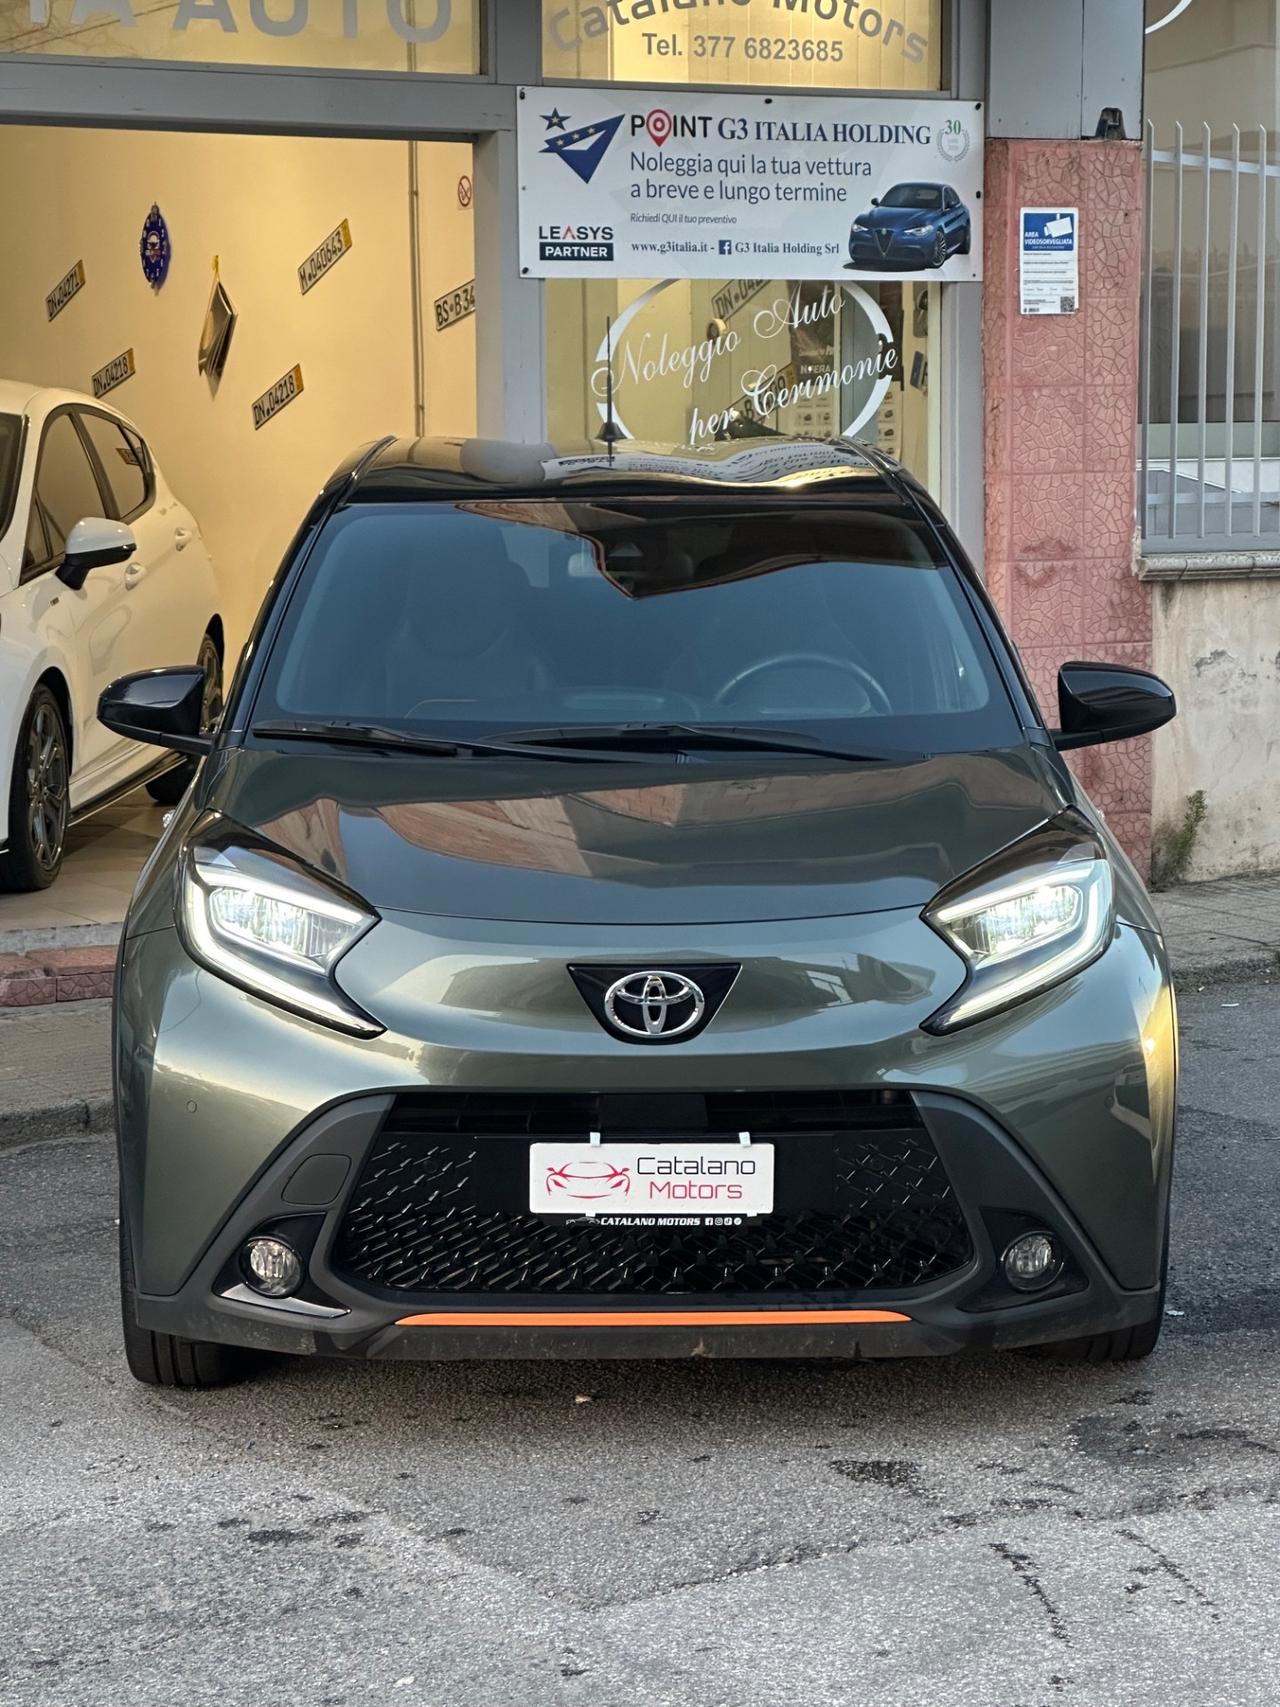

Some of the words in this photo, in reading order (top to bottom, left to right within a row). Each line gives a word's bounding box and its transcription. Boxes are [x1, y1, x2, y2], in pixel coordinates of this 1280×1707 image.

[547, 0, 756, 50] Cata
[773, 0, 928, 64] otors
[642, 33, 682, 56] Tel.
[693, 36, 735, 58] 377
[744, 37, 843, 62] 6823685
[631, 108, 712, 147] POINT
[718, 117, 748, 140] G3
[754, 121, 828, 142] ITALIA
[832, 123, 931, 145] HOLDING
[944, 119, 961, 135] 30
[630, 151, 713, 176] Noleggia
[718, 154, 746, 177] qui
[751, 155, 766, 174] la
[771, 156, 801, 175] tua
[805, 158, 872, 176] vettura
[630, 183, 641, 198] a
[646, 179, 699, 199] breve
[703, 185, 714, 199] e
[719, 180, 770, 204] lungo
[775, 182, 847, 202] termine
[630, 212, 660, 223] Richiedi
[662, 213, 677, 224] QUI
[684, 213, 697, 223] tuo
[698, 214, 737, 226] preventivo
[539, 226, 613, 240] LEASYS
[545, 246, 608, 257] PARTNER
[631, 241, 707, 255] www.g3italia.it
[735, 242, 750, 253] G3
[753, 242, 780, 254] Italia
[782, 242, 823, 256] Holding
[825, 243, 839, 254] Srl
[591, 331, 742, 397] Noleggio
[754, 280, 845, 338] Auto
[689, 407, 738, 446] per
[741, 349, 898, 419] Cerimonie
[637, 1156, 756, 1175] Catalano
[650, 1180, 743, 1200] Motors
[601, 1217, 655, 1226] CATALANO
[657, 1217, 700, 1226] MOTORS
